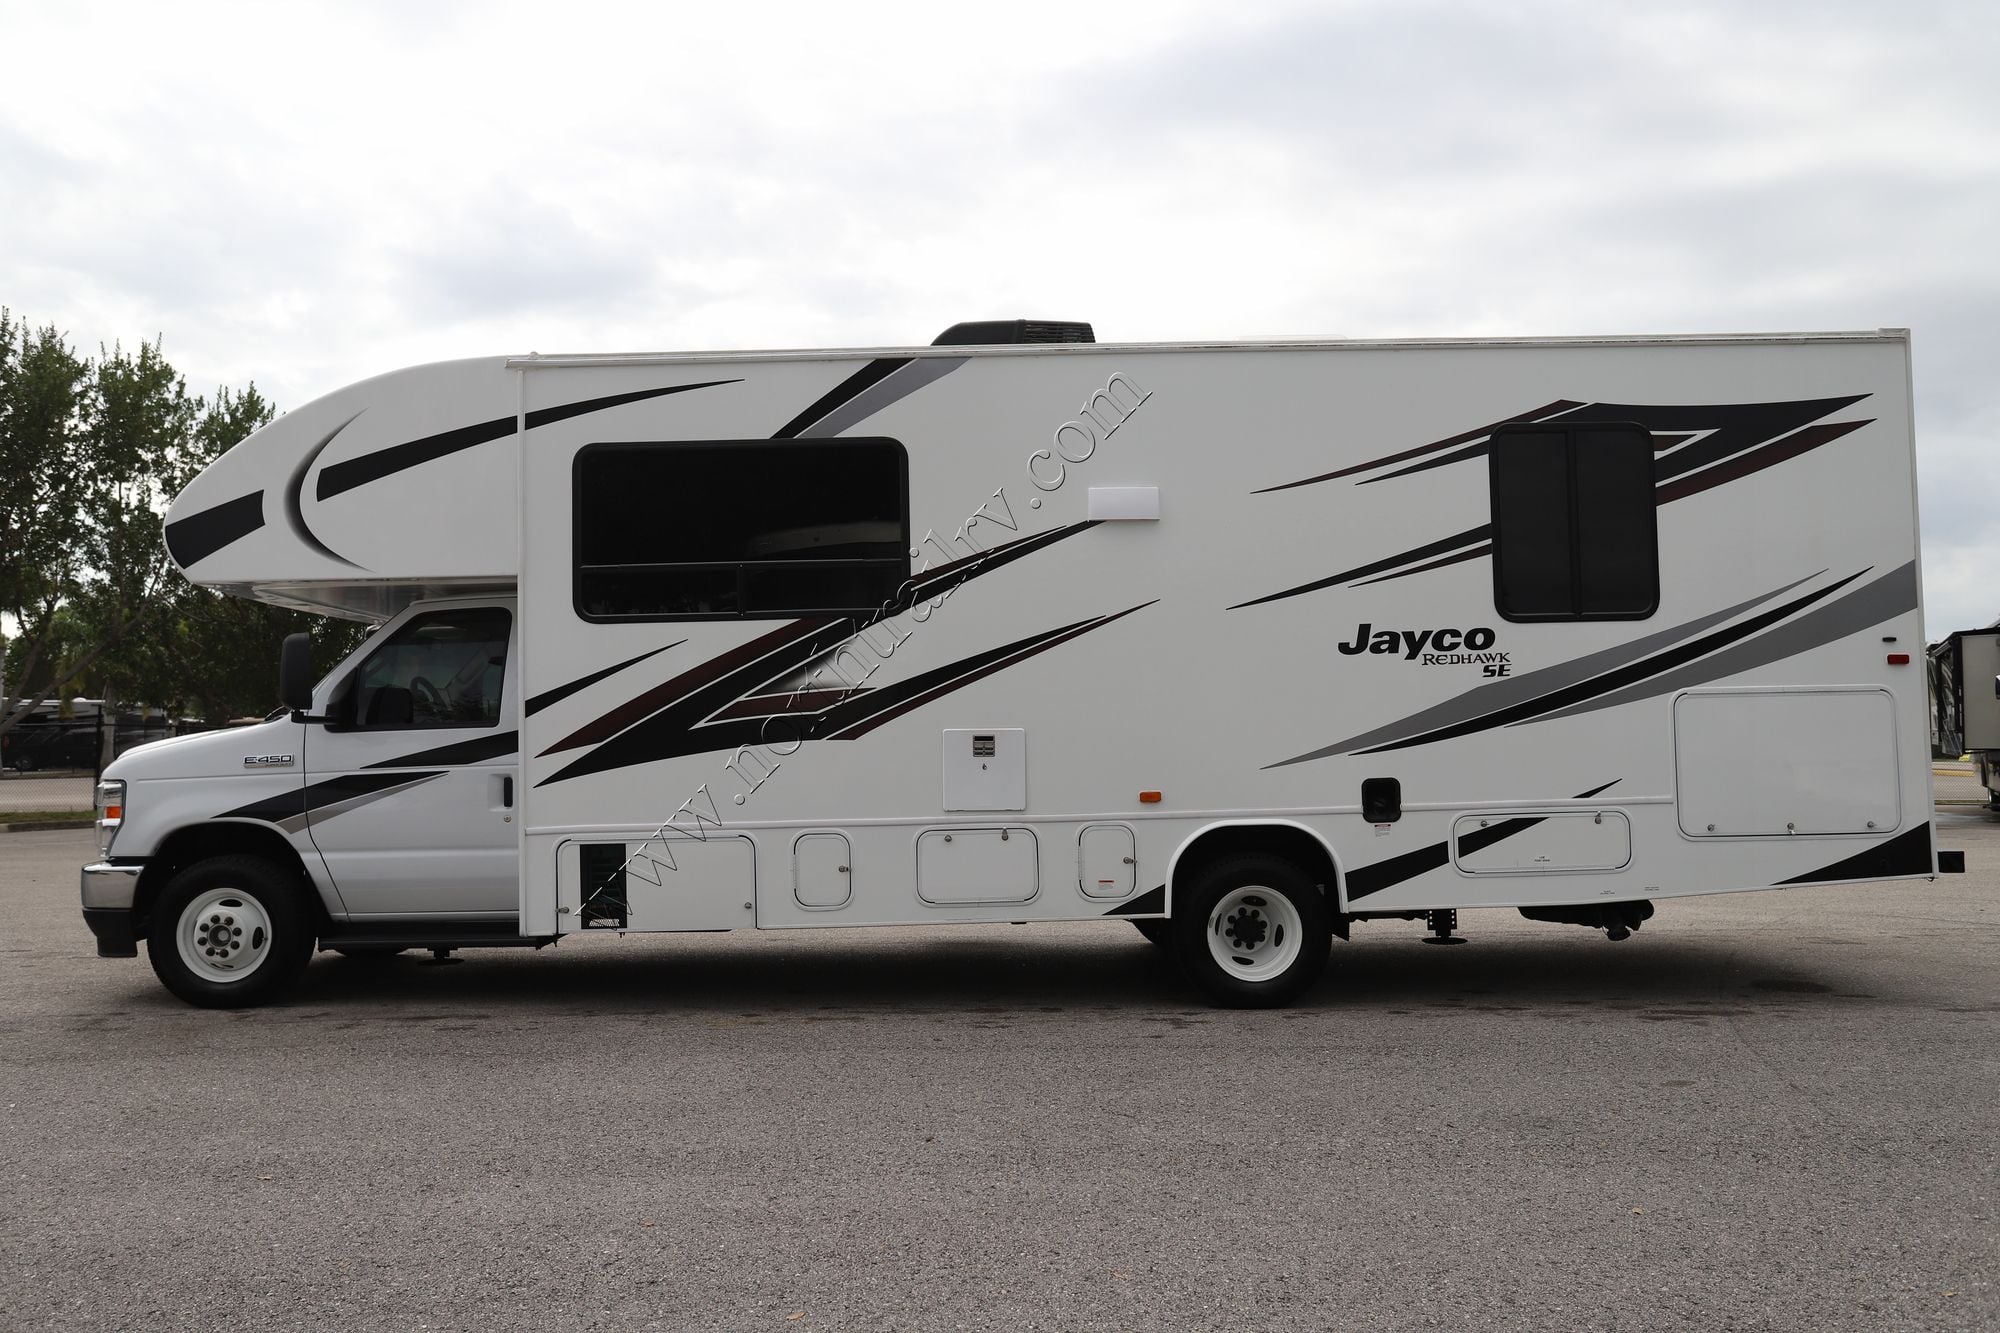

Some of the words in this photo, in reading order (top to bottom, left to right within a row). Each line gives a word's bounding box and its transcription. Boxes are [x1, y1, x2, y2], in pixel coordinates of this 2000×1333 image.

[1338, 623, 1496, 660] Jayco
[1421, 653, 1511, 666] REDHAWK
[1482, 664, 1512, 678] SE
